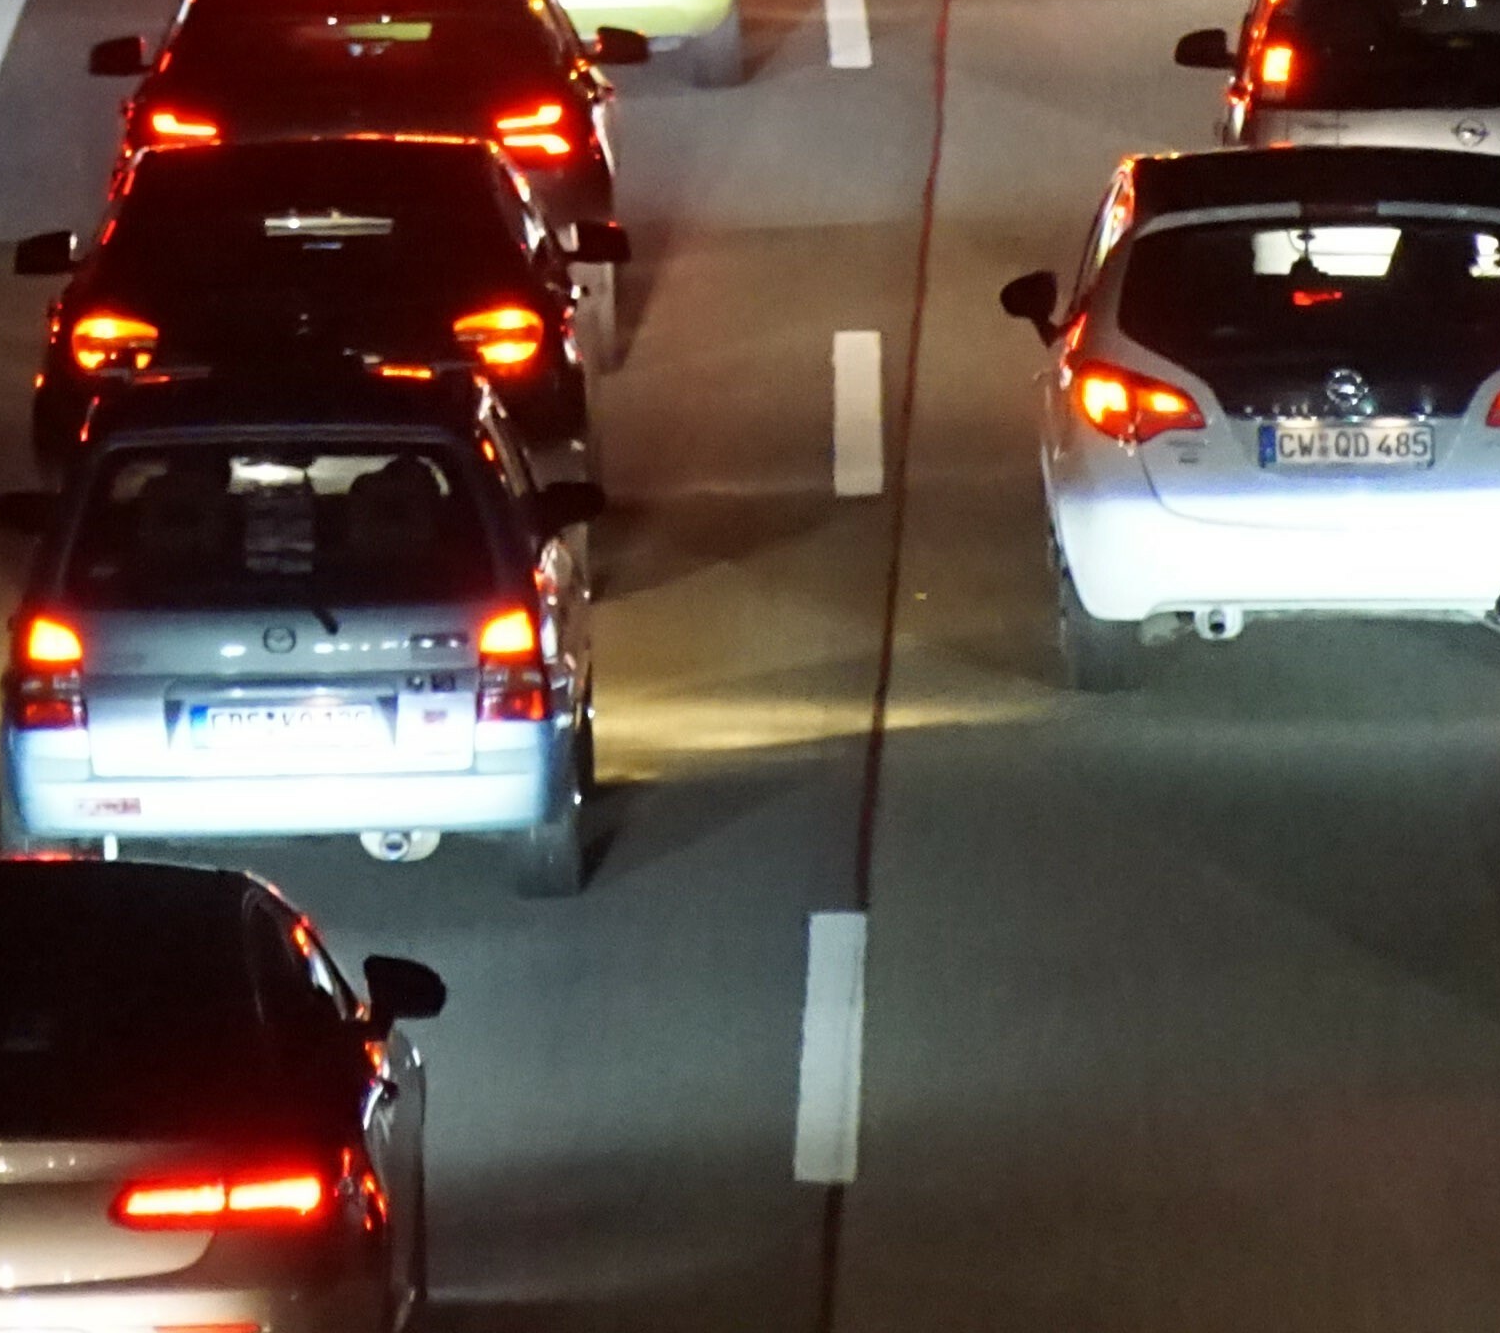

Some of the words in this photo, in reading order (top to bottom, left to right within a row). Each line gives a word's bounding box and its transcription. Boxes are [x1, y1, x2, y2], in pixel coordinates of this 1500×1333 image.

[1279, 435, 1314, 459] CW
[1333, 431, 1370, 458] QD
[1377, 433, 1429, 458] 485
